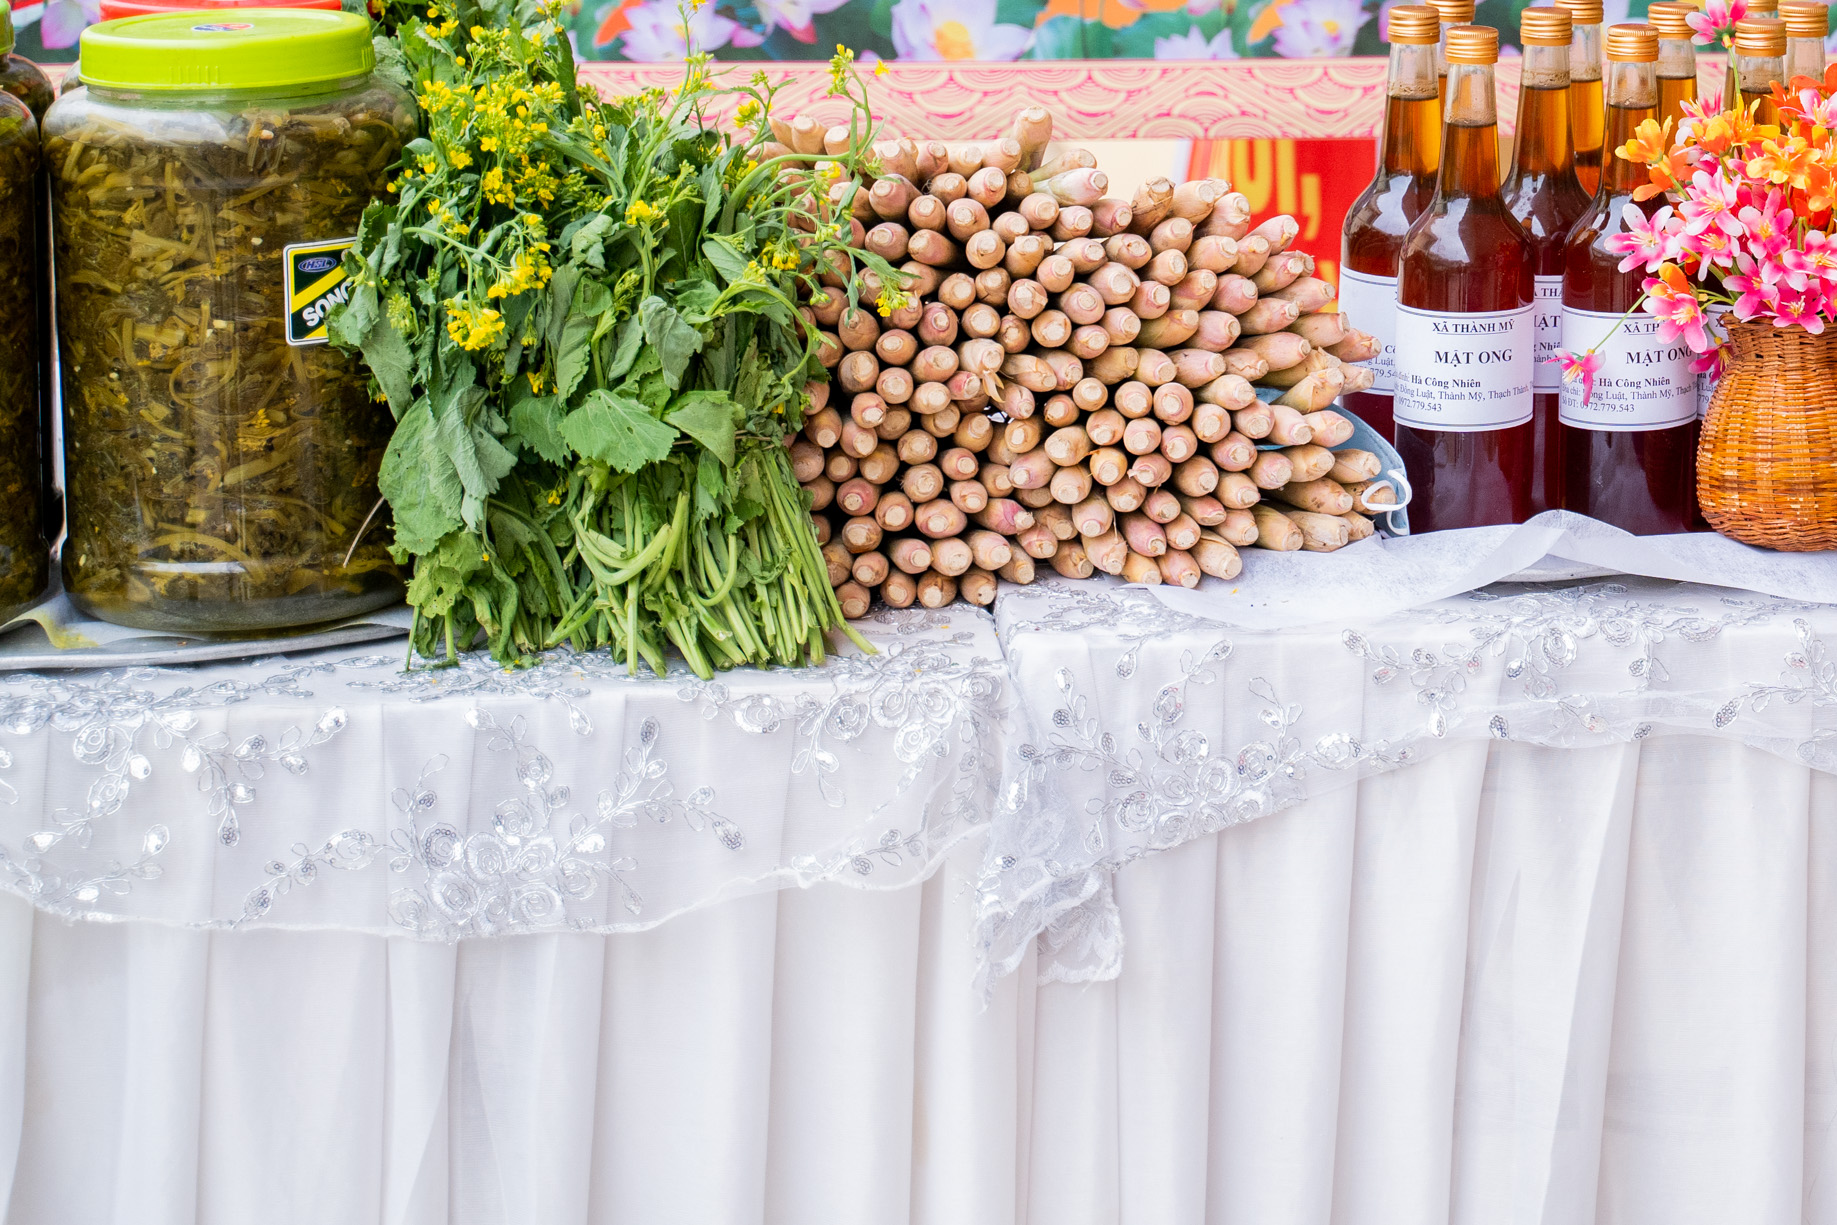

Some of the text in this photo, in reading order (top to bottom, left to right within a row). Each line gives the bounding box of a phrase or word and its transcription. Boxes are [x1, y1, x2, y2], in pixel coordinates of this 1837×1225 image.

[1432, 318, 1515, 333] XÃ THÀNH MỸ
[1534, 313, 1561, 331] ẬT
[1623, 321, 1640, 333] XÃ
[1434, 348, 1513, 367] MẬT ONG
[1625, 348, 1664, 367] MẬT
[1424, 376, 1449, 390] Công
[1452, 378, 1481, 388] Nhiên
[1598, 377, 1613, 387] Hà
[1615, 378, 1642, 389] Công
[1644, 376, 1671, 388] Nhiên
[1438, 390, 1466, 401] Thành
[1630, 390, 1657, 401] Thành
